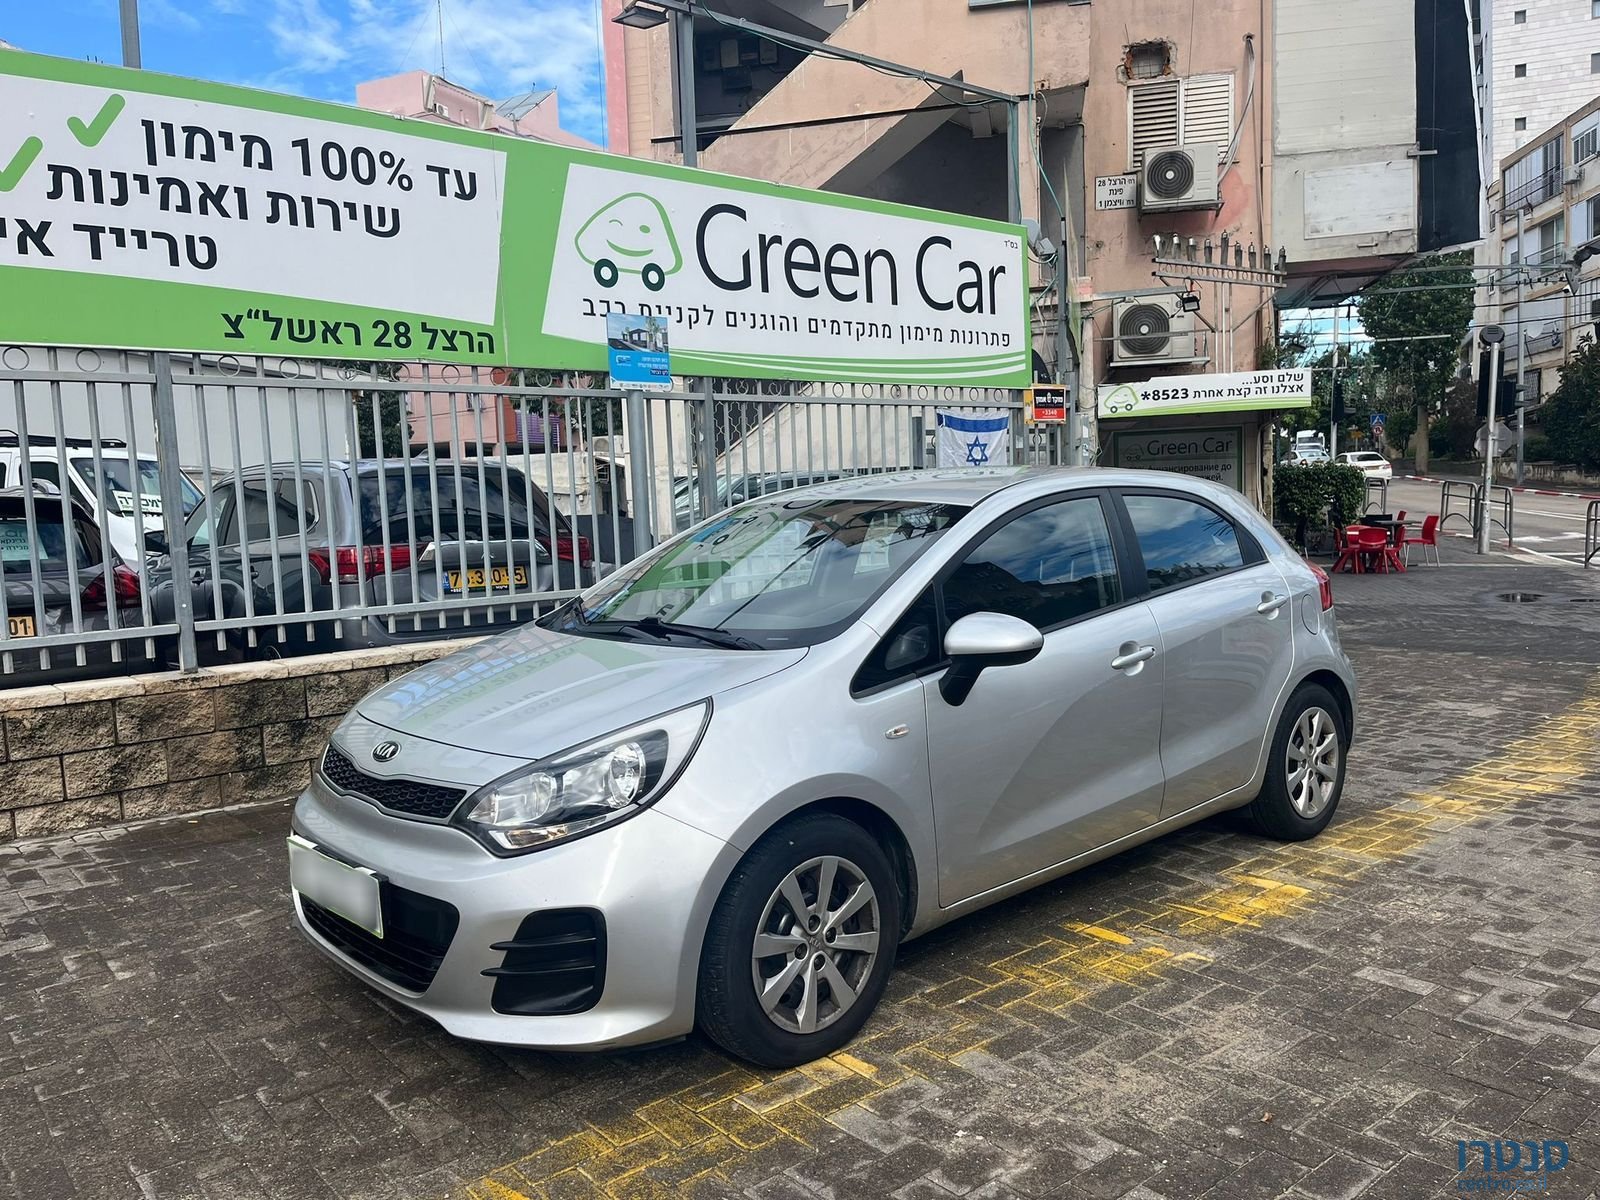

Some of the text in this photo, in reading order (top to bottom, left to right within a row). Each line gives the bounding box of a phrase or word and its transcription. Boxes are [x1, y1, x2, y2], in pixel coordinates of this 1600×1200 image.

[140, 118, 477, 201] עד 100% מימון
[1098, 179, 1106, 187] 28
[1108, 187, 1124, 196] פינת
[46, 163, 401, 238] שירות ואמינות
[72, 223, 218, 270] טרייד
[696, 203, 1006, 316] Green Car
[220, 307, 495, 354] הרצל 28 ראשל"צ
[583, 298, 1010, 347] פתרונות מימון מתקדמים והוגנים לקניית רכב
[1242, 372, 1304, 385] שלם וסע...
[1193, 388, 1224, 399] אחרת
[1227, 386, 1251, 398] קצת
[1254, 385, 1268, 395] זה
[1271, 383, 1304, 395] אצלנו
[1147, 437, 1232, 456] Green Car
[375, 742, 396, 758] KIA
